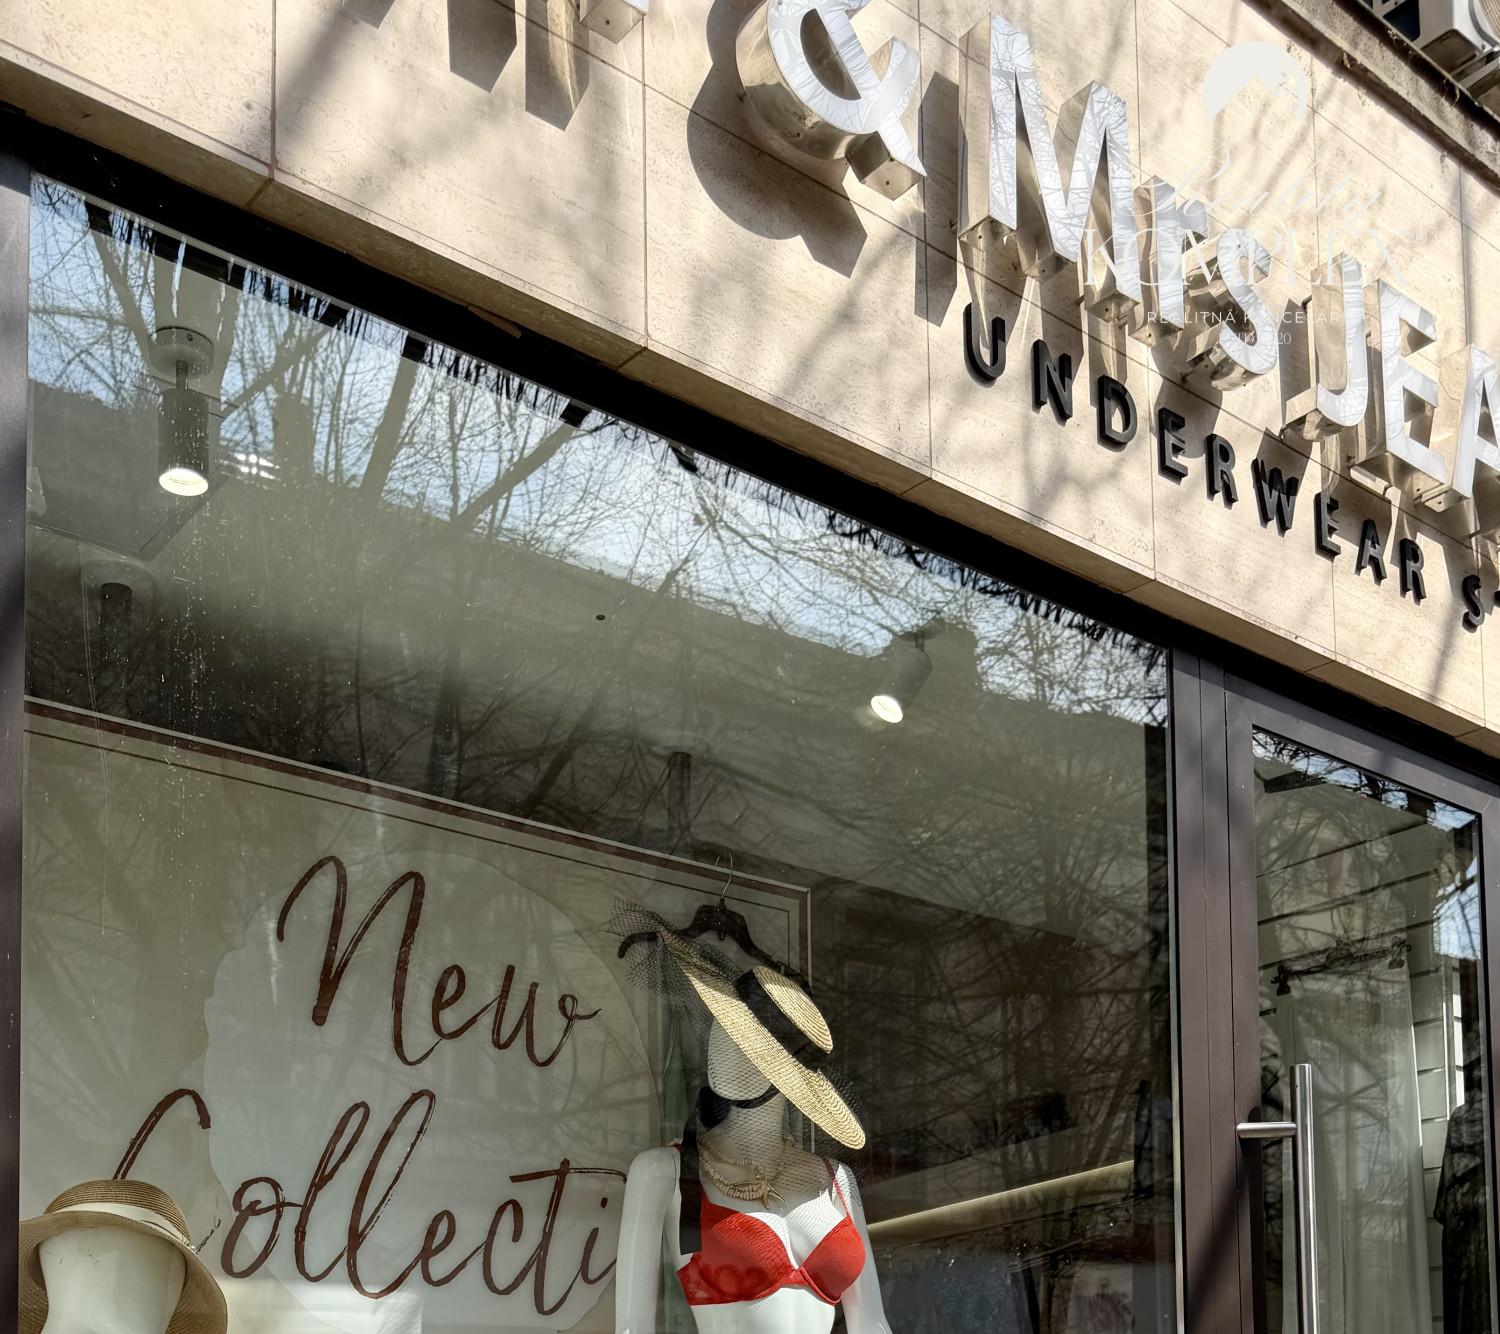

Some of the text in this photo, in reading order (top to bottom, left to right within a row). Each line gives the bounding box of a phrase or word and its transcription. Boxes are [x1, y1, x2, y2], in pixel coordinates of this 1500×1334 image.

[960, 10, 1280, 390] Mrs
[963, 302, 1500, 633] UNDERWEAR S
[277, 855, 602, 1068] New
